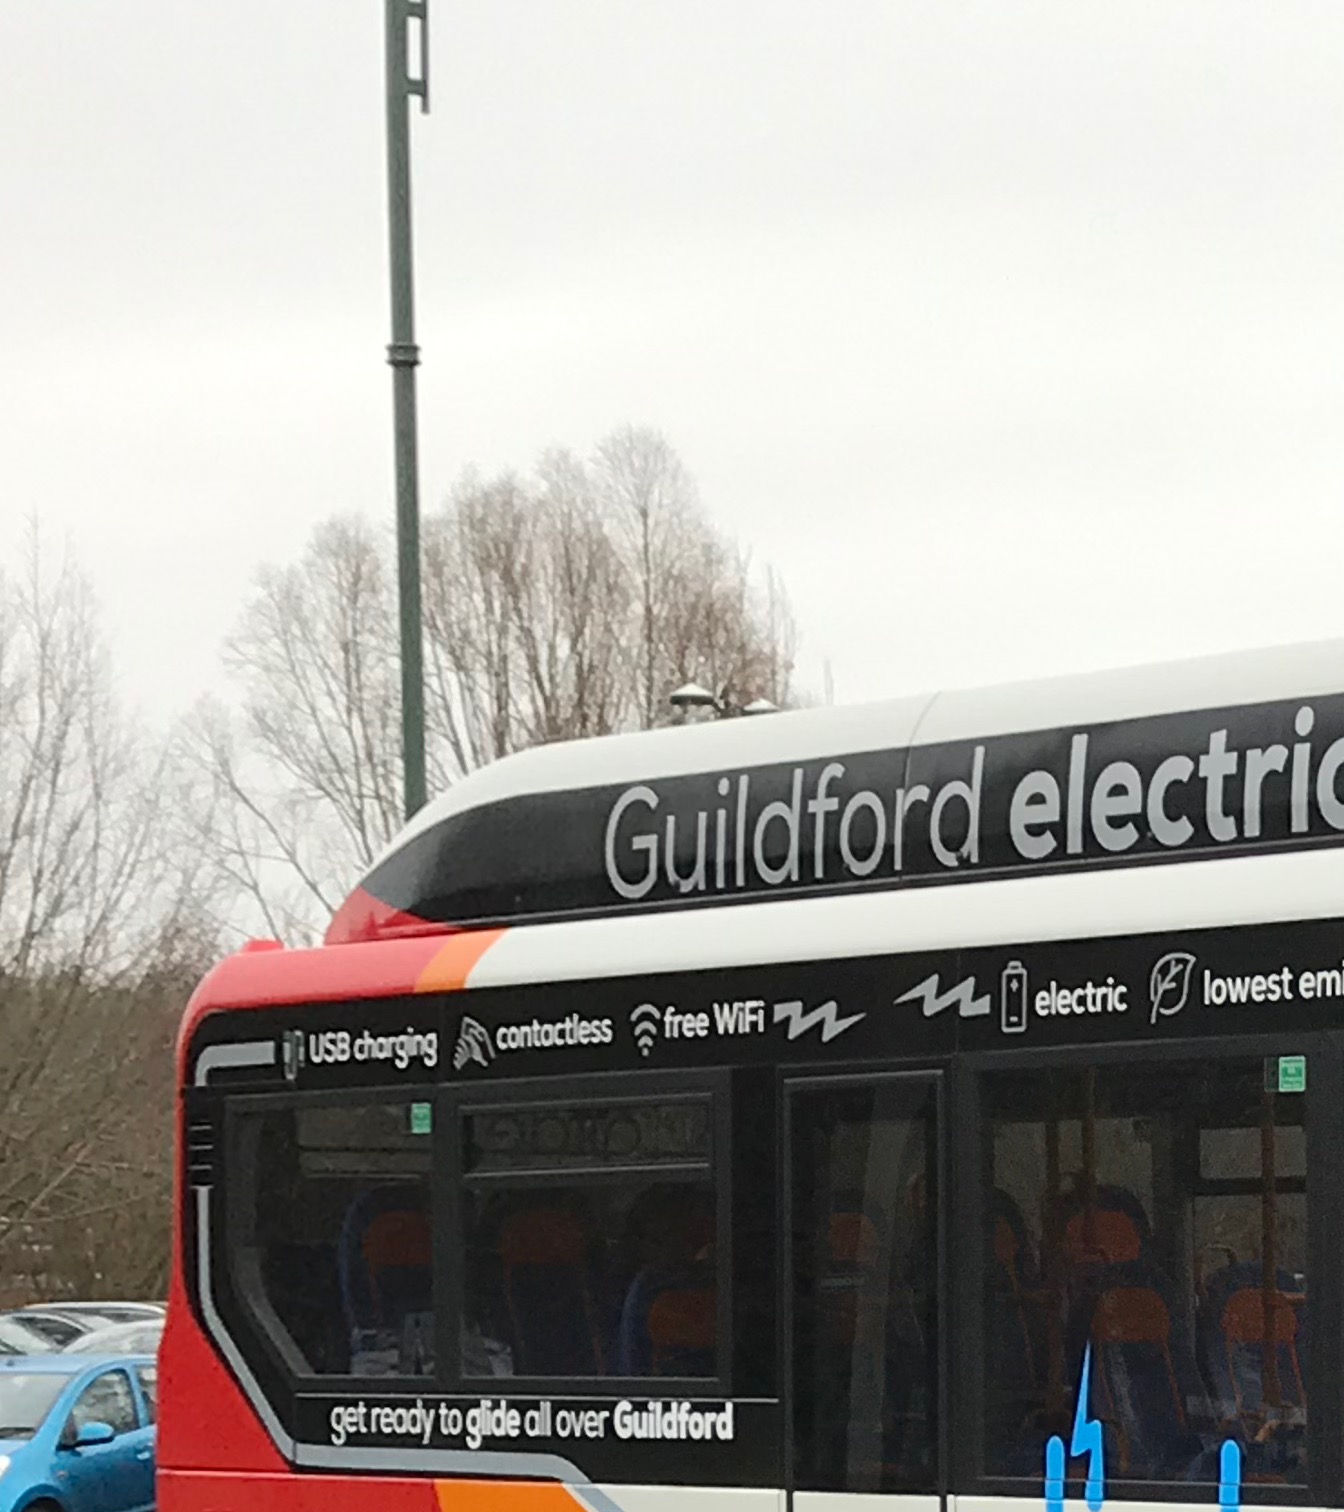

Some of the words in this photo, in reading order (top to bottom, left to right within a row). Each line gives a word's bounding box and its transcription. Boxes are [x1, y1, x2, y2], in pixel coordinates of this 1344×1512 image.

[605, 744, 986, 899] Guildford
[1034, 977, 1129, 1017] electric
[1203, 968, 1297, 1006] lowest
[496, 1013, 613, 1052] contactless
[663, 1005, 710, 1040] free
[713, 998, 766, 1036] WiFi
[308, 1030, 351, 1065] USB
[353, 1025, 438, 1068] charging
[330, 1402, 367, 1446] get
[371, 1400, 436, 1445] ready
[438, 1402, 463, 1436] to
[465, 1400, 521, 1449] glide
[524, 1401, 552, 1437] all
[556, 1408, 609, 1438] over
[613, 1401, 734, 1440] Guildford
